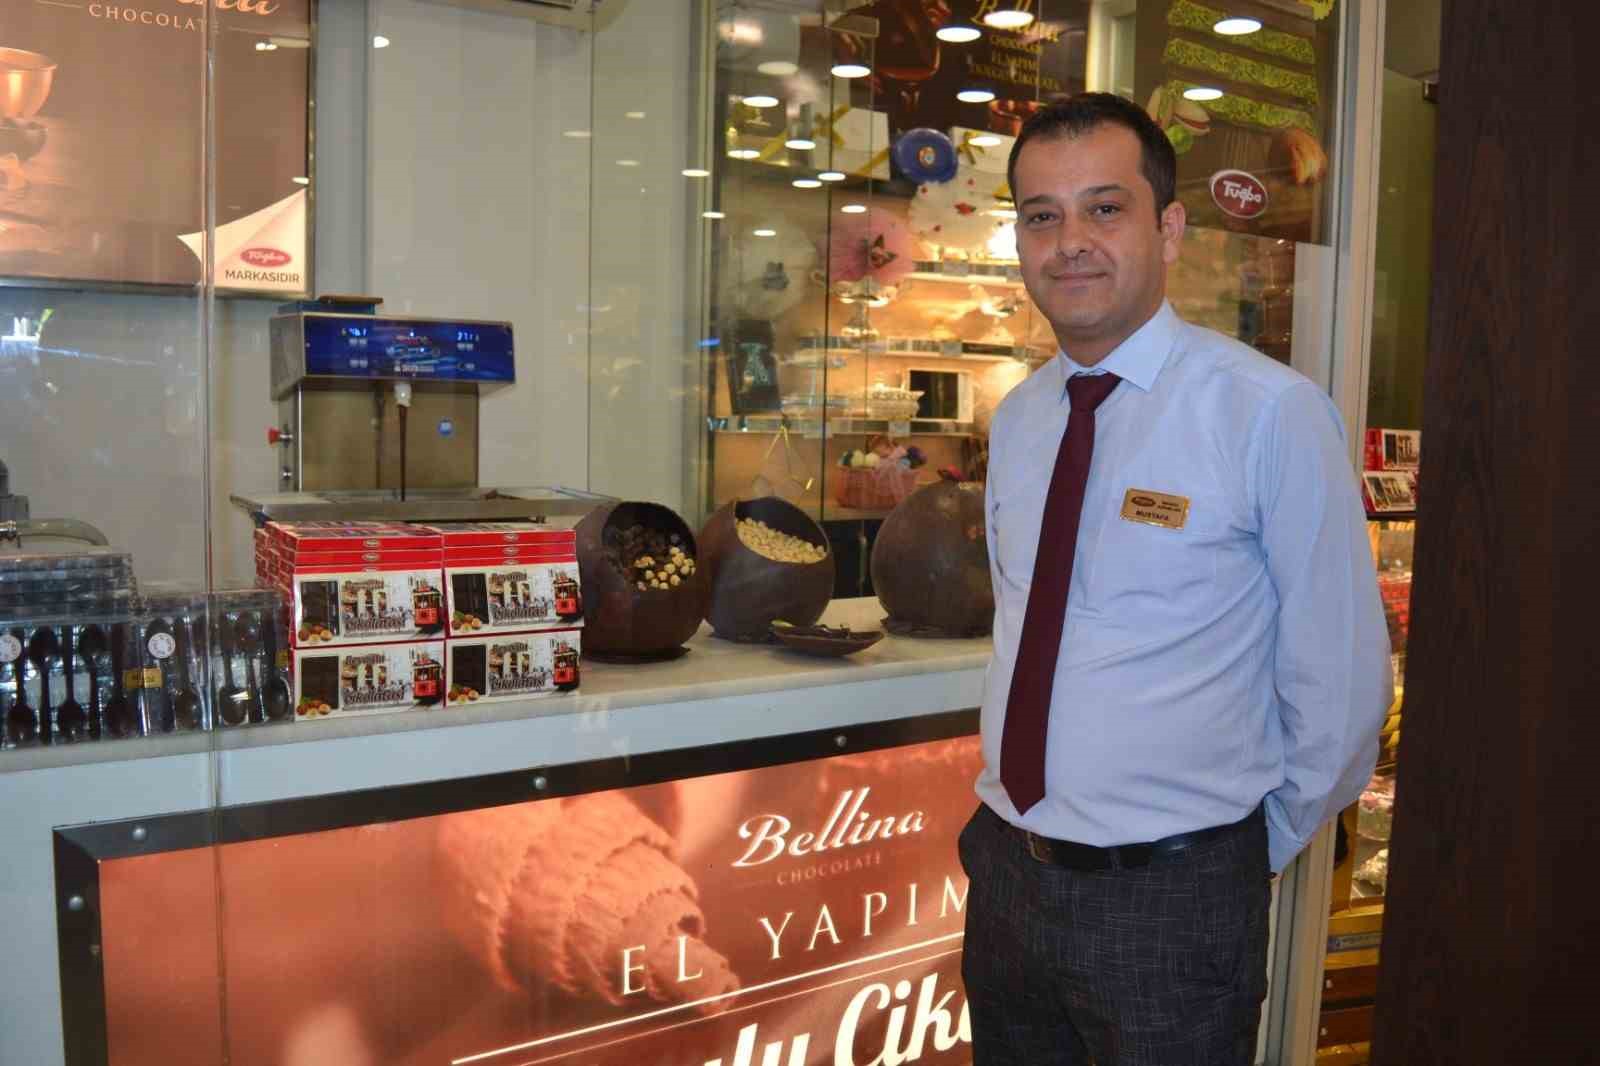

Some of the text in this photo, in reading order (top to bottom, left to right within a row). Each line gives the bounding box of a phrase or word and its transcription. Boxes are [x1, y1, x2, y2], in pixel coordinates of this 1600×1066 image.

[224, 270, 300, 283] MARKASIDIR
[731, 786, 926, 868] Bellina
[776, 852, 882, 886] CHOCOLATE
[623, 935, 703, 996] EL
